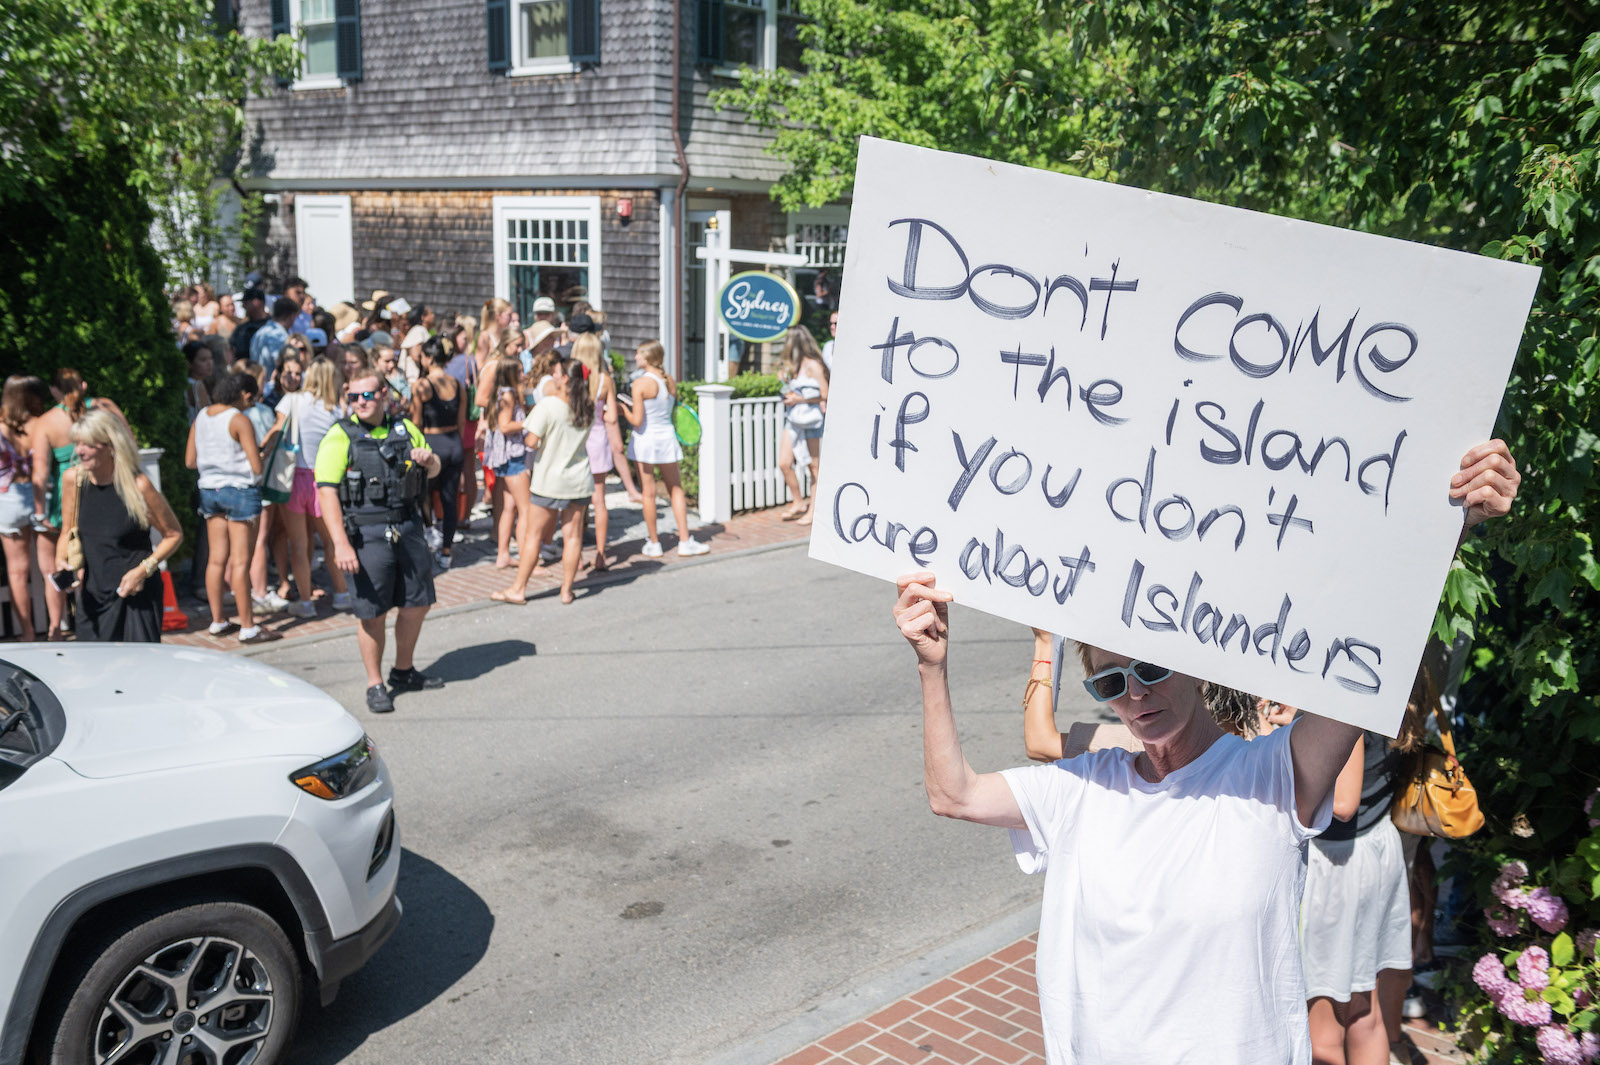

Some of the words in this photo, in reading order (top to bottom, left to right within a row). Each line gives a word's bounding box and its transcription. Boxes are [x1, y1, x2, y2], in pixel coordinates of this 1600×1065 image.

[725, 281, 790, 324] Sydney
[886, 217, 1140, 342] Don't
[868, 316, 960, 385] to
[999, 341, 1132, 427] the
[1165, 378, 1408, 517] island
[870, 391, 931, 473] if
[947, 426, 1083, 512] you
[1105, 445, 1315, 552] don't
[832, 481, 939, 568] Care
[958, 526, 1096, 606] about
[1120, 558, 1383, 695] Islanders
